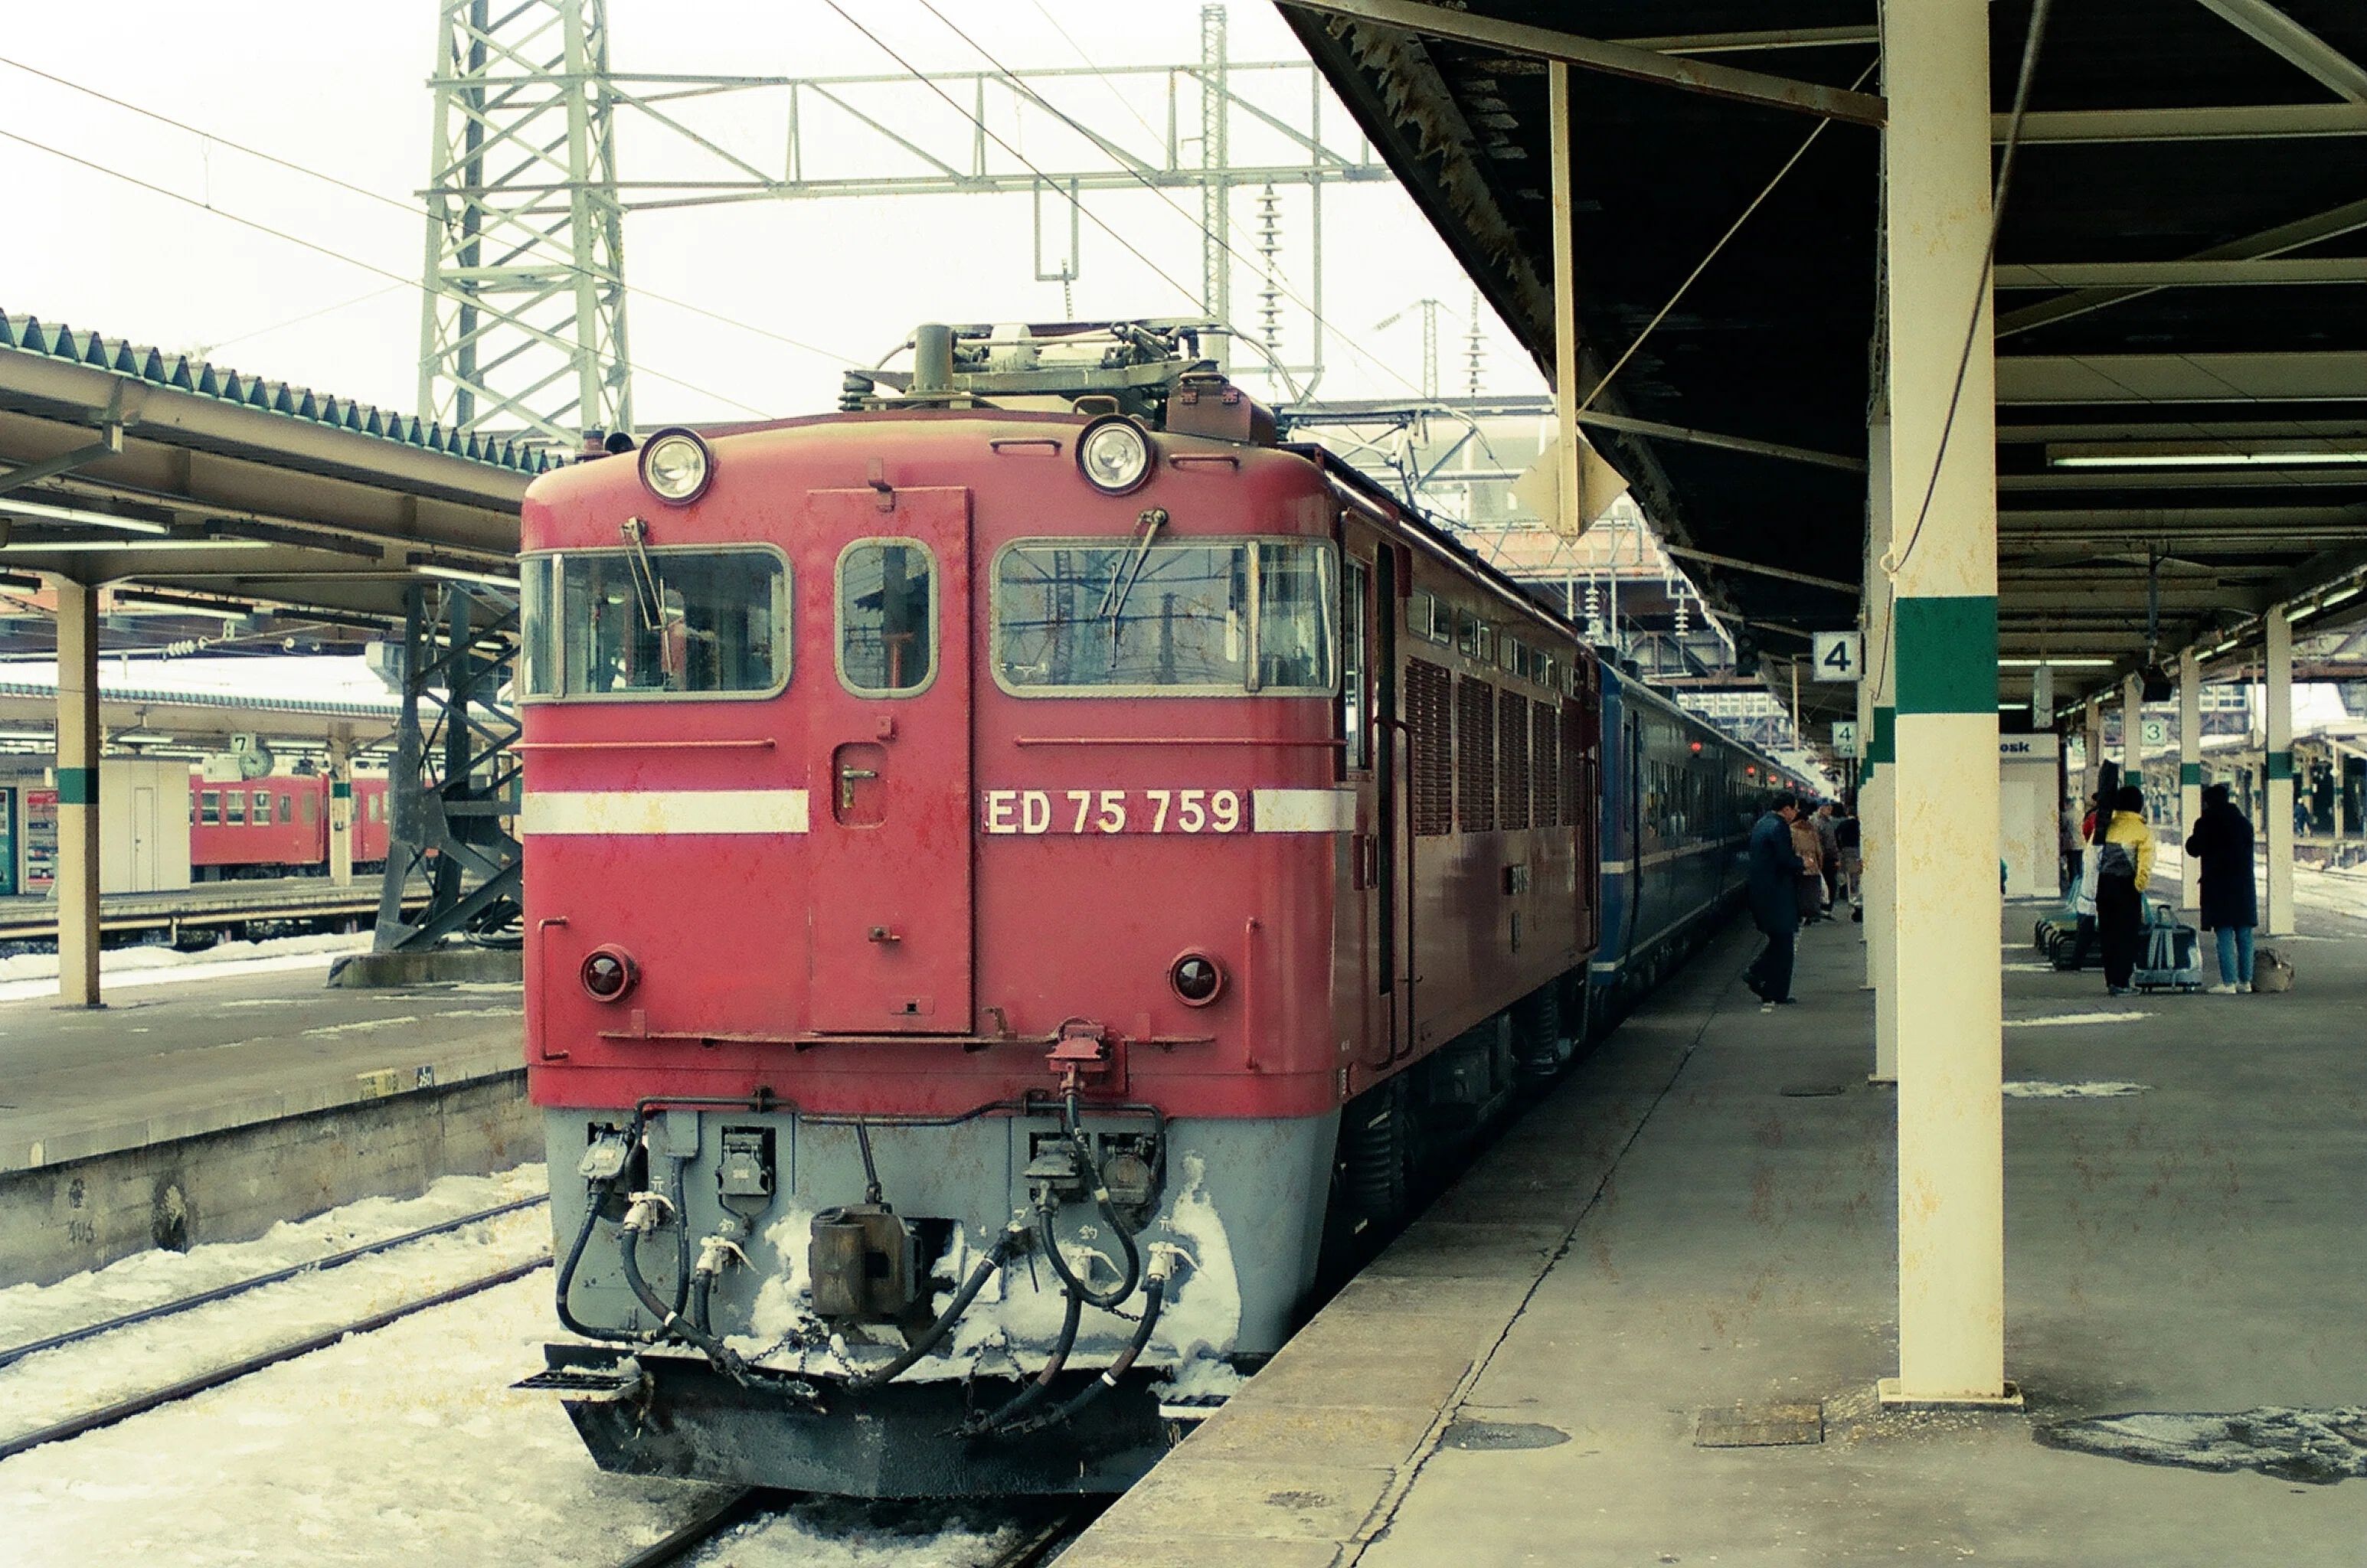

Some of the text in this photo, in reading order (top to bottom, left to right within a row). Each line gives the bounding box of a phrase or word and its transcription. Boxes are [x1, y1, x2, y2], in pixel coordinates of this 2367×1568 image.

[1824, 641, 1852, 671] 4
[1839, 727, 1852, 741] 4
[2147, 724, 2160, 740] 3
[234, 737, 247, 751] 7
[989, 790, 1240, 833] ED 75 759
[1159, 1216, 1171, 1232] 元
